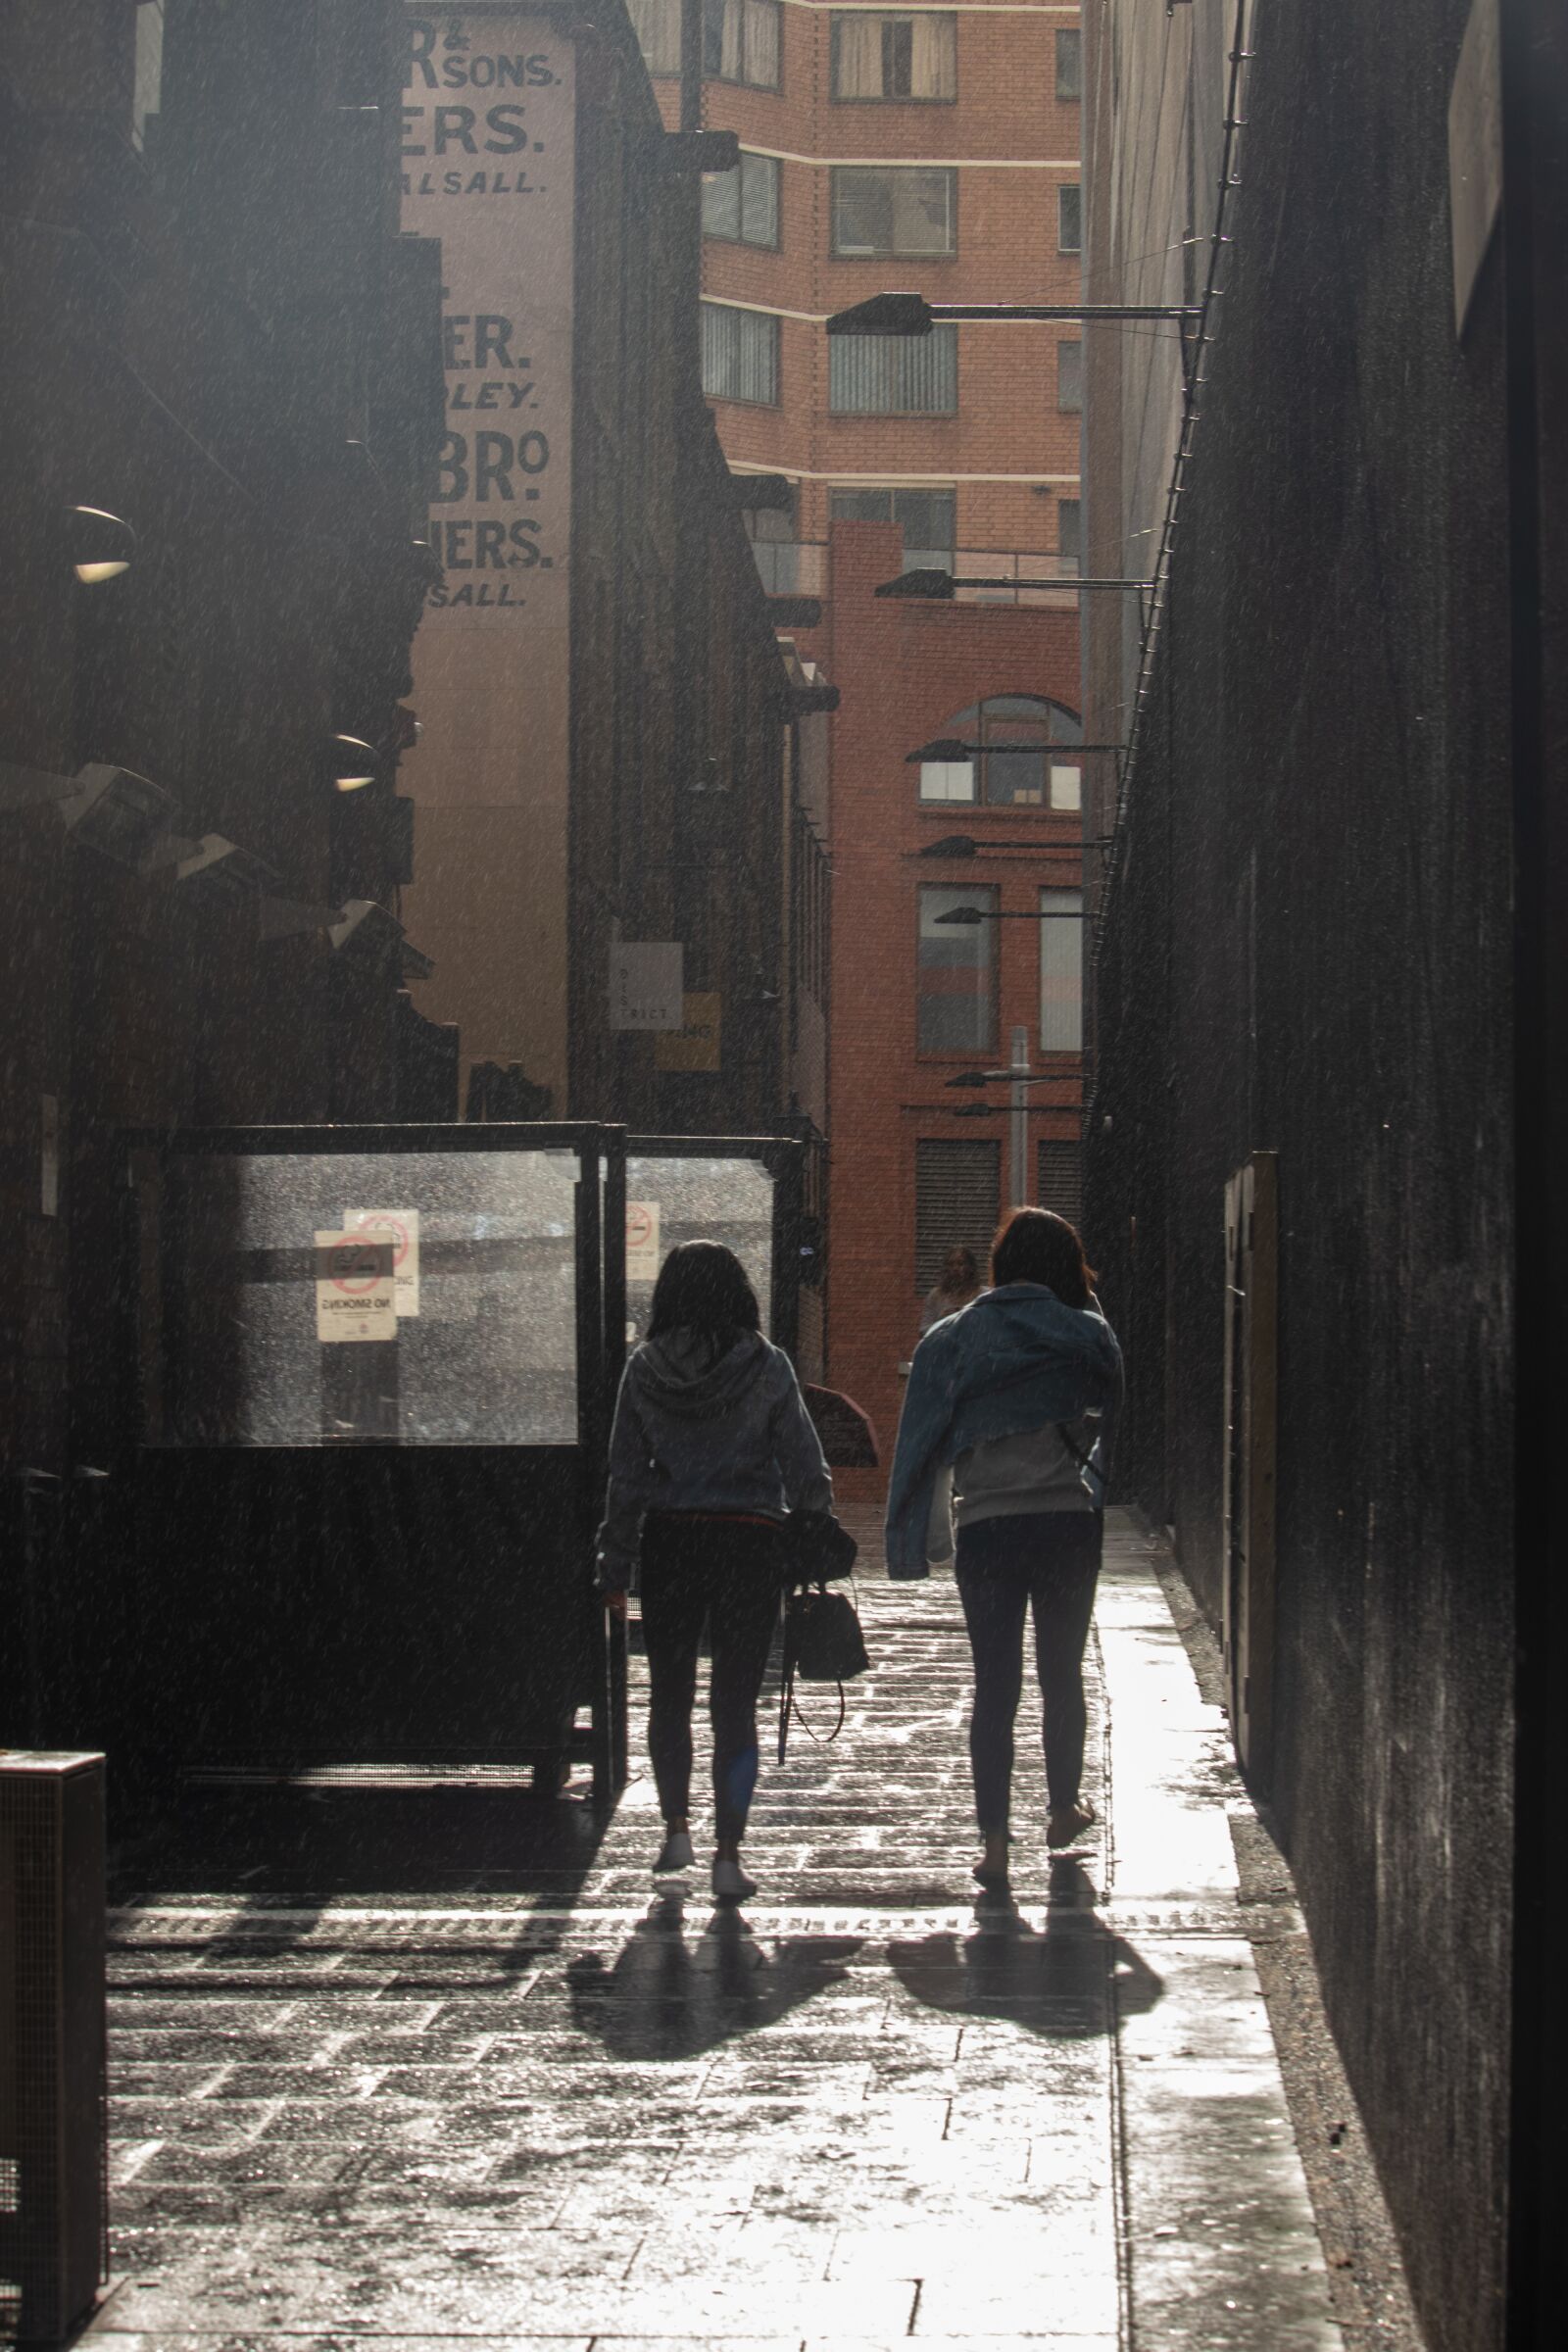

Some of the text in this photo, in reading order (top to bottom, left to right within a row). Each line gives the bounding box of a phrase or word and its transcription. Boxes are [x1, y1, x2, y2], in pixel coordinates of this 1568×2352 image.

[443, 55, 562, 88] SONS.
[443, 315, 531, 369] ER.
[442, 382, 539, 410] LEY.
